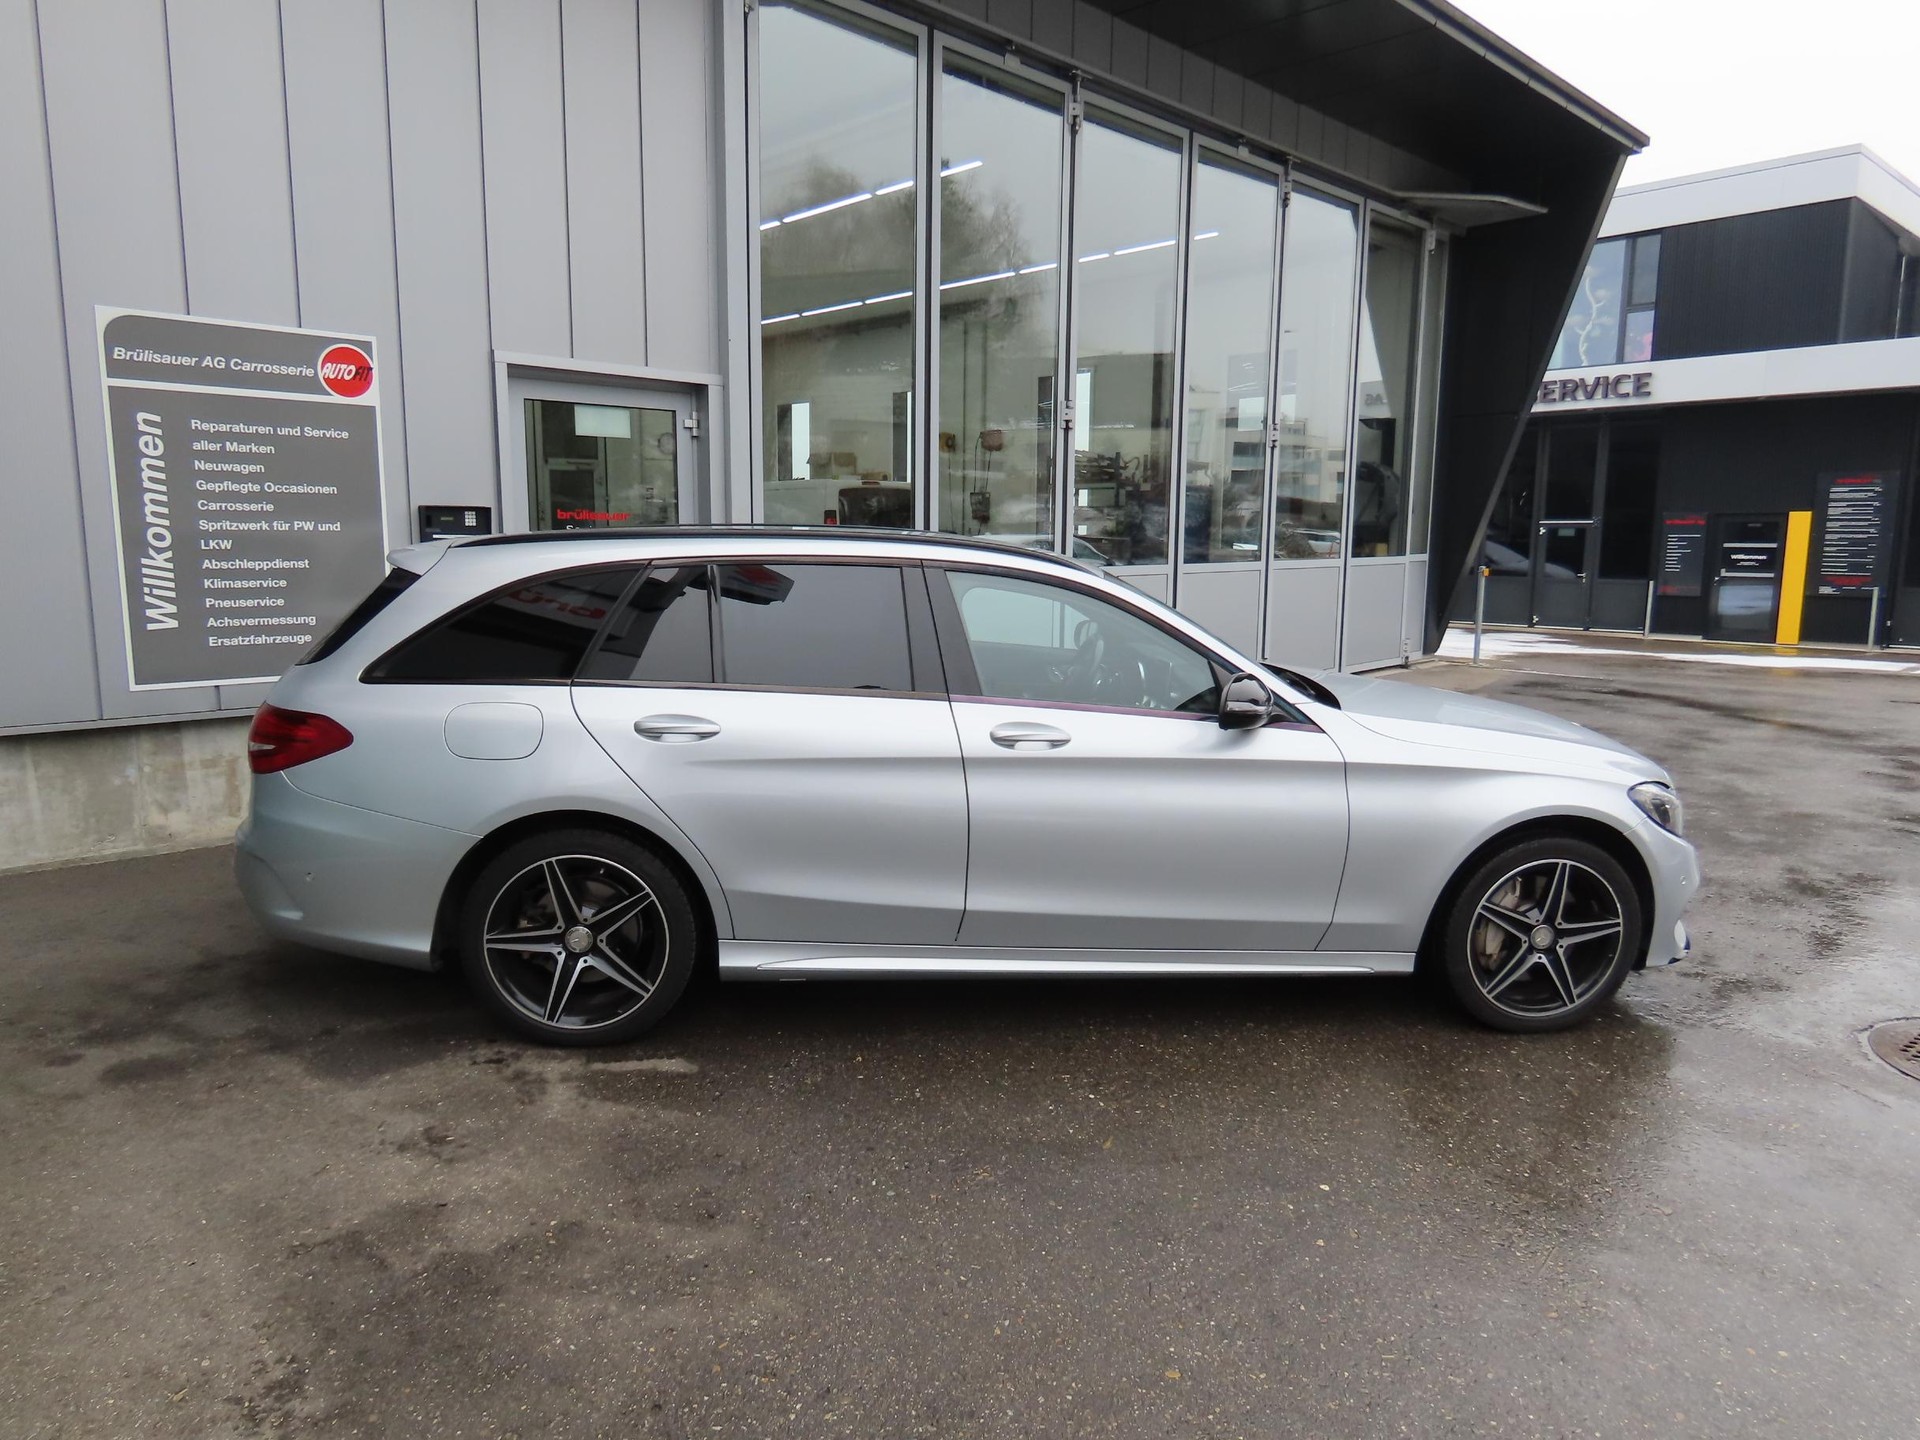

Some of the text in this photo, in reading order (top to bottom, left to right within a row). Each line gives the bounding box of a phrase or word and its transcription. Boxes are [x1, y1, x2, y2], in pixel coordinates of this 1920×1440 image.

[113, 346, 315, 377] Brülisauer AG Carrosserie
[1536, 372, 1653, 403] ERVICE
[191, 419, 349, 439] Reparaturen und Service
[192, 440, 275, 454] aller Marken
[194, 460, 265, 476] Neuwagen
[196, 479, 337, 495] Gepflegte Occasionen
[197, 500, 274, 512] Carrosserie
[136, 411, 179, 631] Willkommen
[199, 519, 341, 533] Spritzwerk für PW und
[201, 539, 232, 550] LKW
[202, 558, 310, 571] Abschleppdienst
[204, 577, 287, 589] Klimaservice
[205, 596, 285, 608] Pneuservice
[207, 614, 316, 628] Achsvermessung
[208, 632, 312, 647] Ersatzfahrzeuge
